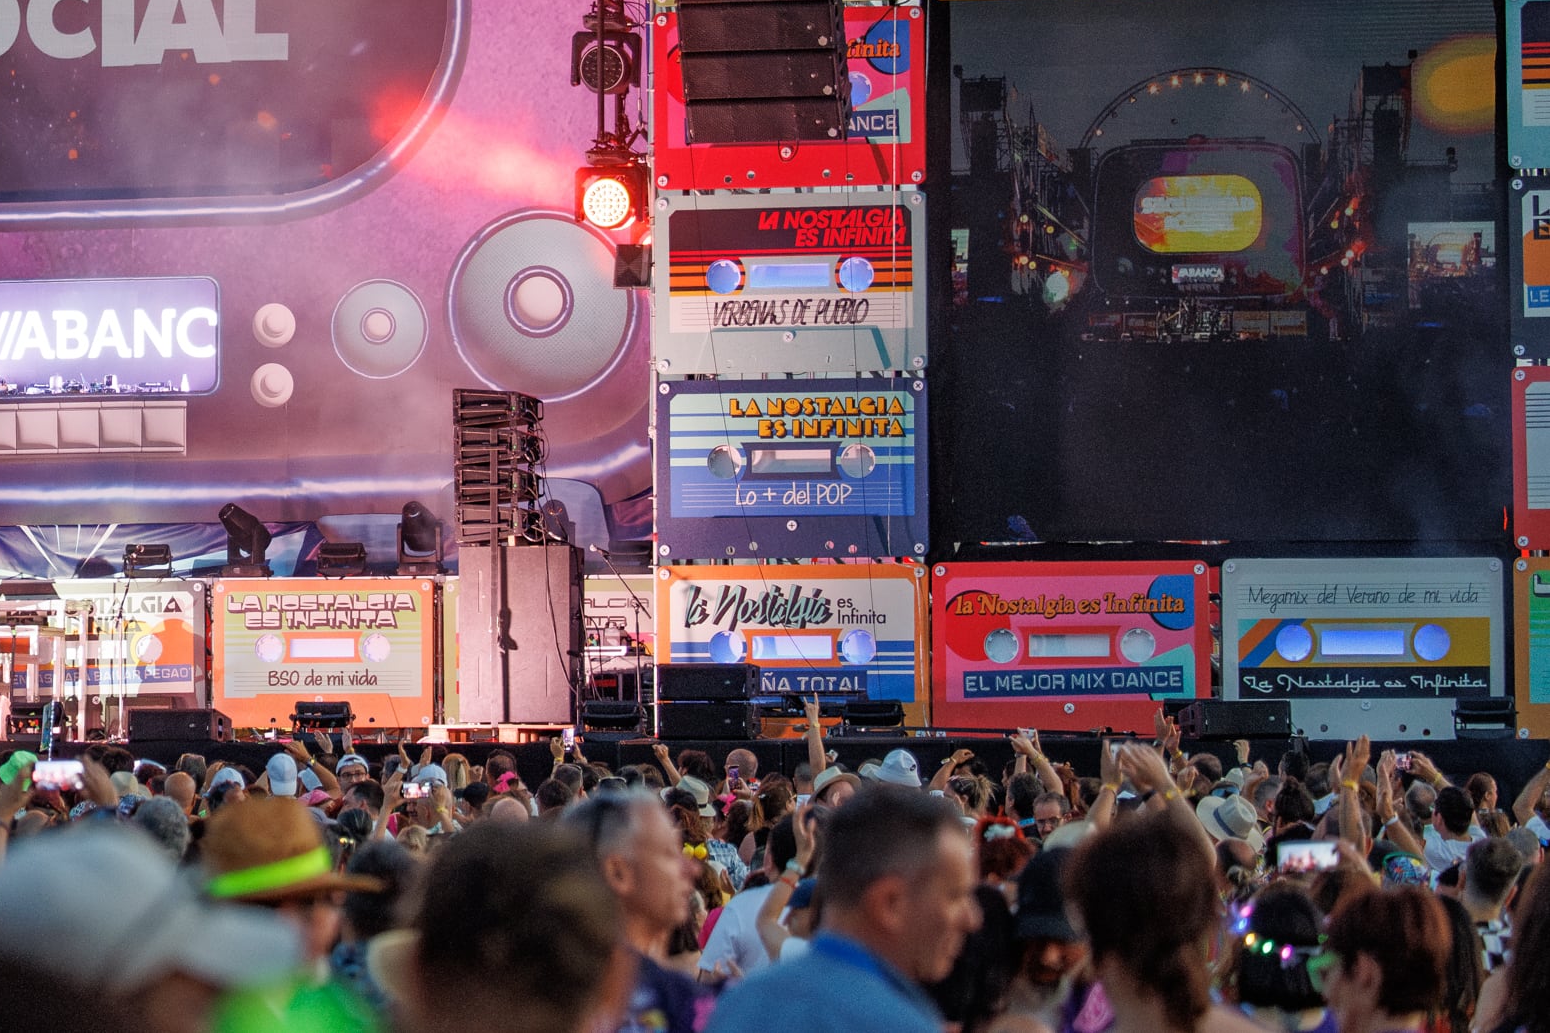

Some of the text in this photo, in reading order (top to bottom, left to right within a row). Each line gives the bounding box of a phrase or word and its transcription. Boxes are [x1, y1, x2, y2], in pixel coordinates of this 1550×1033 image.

[758, 208, 904, 230] LA NOSTALGIA
[795, 226, 906, 247] ES INFINITA
[713, 297, 870, 328] VERBENAS DE PUEBLO
[729, 396, 906, 418] LA NOSTALGIA
[758, 418, 906, 438] ES INFINITA
[735, 484, 757, 506] Lo
[783, 482, 810, 506] del
[816, 483, 853, 505] POP
[227, 593, 416, 613] LA NOSTALGIA
[684, 584, 833, 631] la Nostalgia
[955, 592, 1185, 619] la Nostalgia es Infinita
[1249, 582, 1479, 614] Megamix del Verano de mi vida
[244, 610, 398, 630] ES INFINITA
[837, 597, 887, 625] es Infinita
[268, 669, 378, 687] BSO de mi vida
[796, 676, 866, 692] TOTAL
[965, 670, 1182, 692] EL MEJOR MIX DANCE
[1242, 672, 1487, 695] La Nostalgia es Infinita
